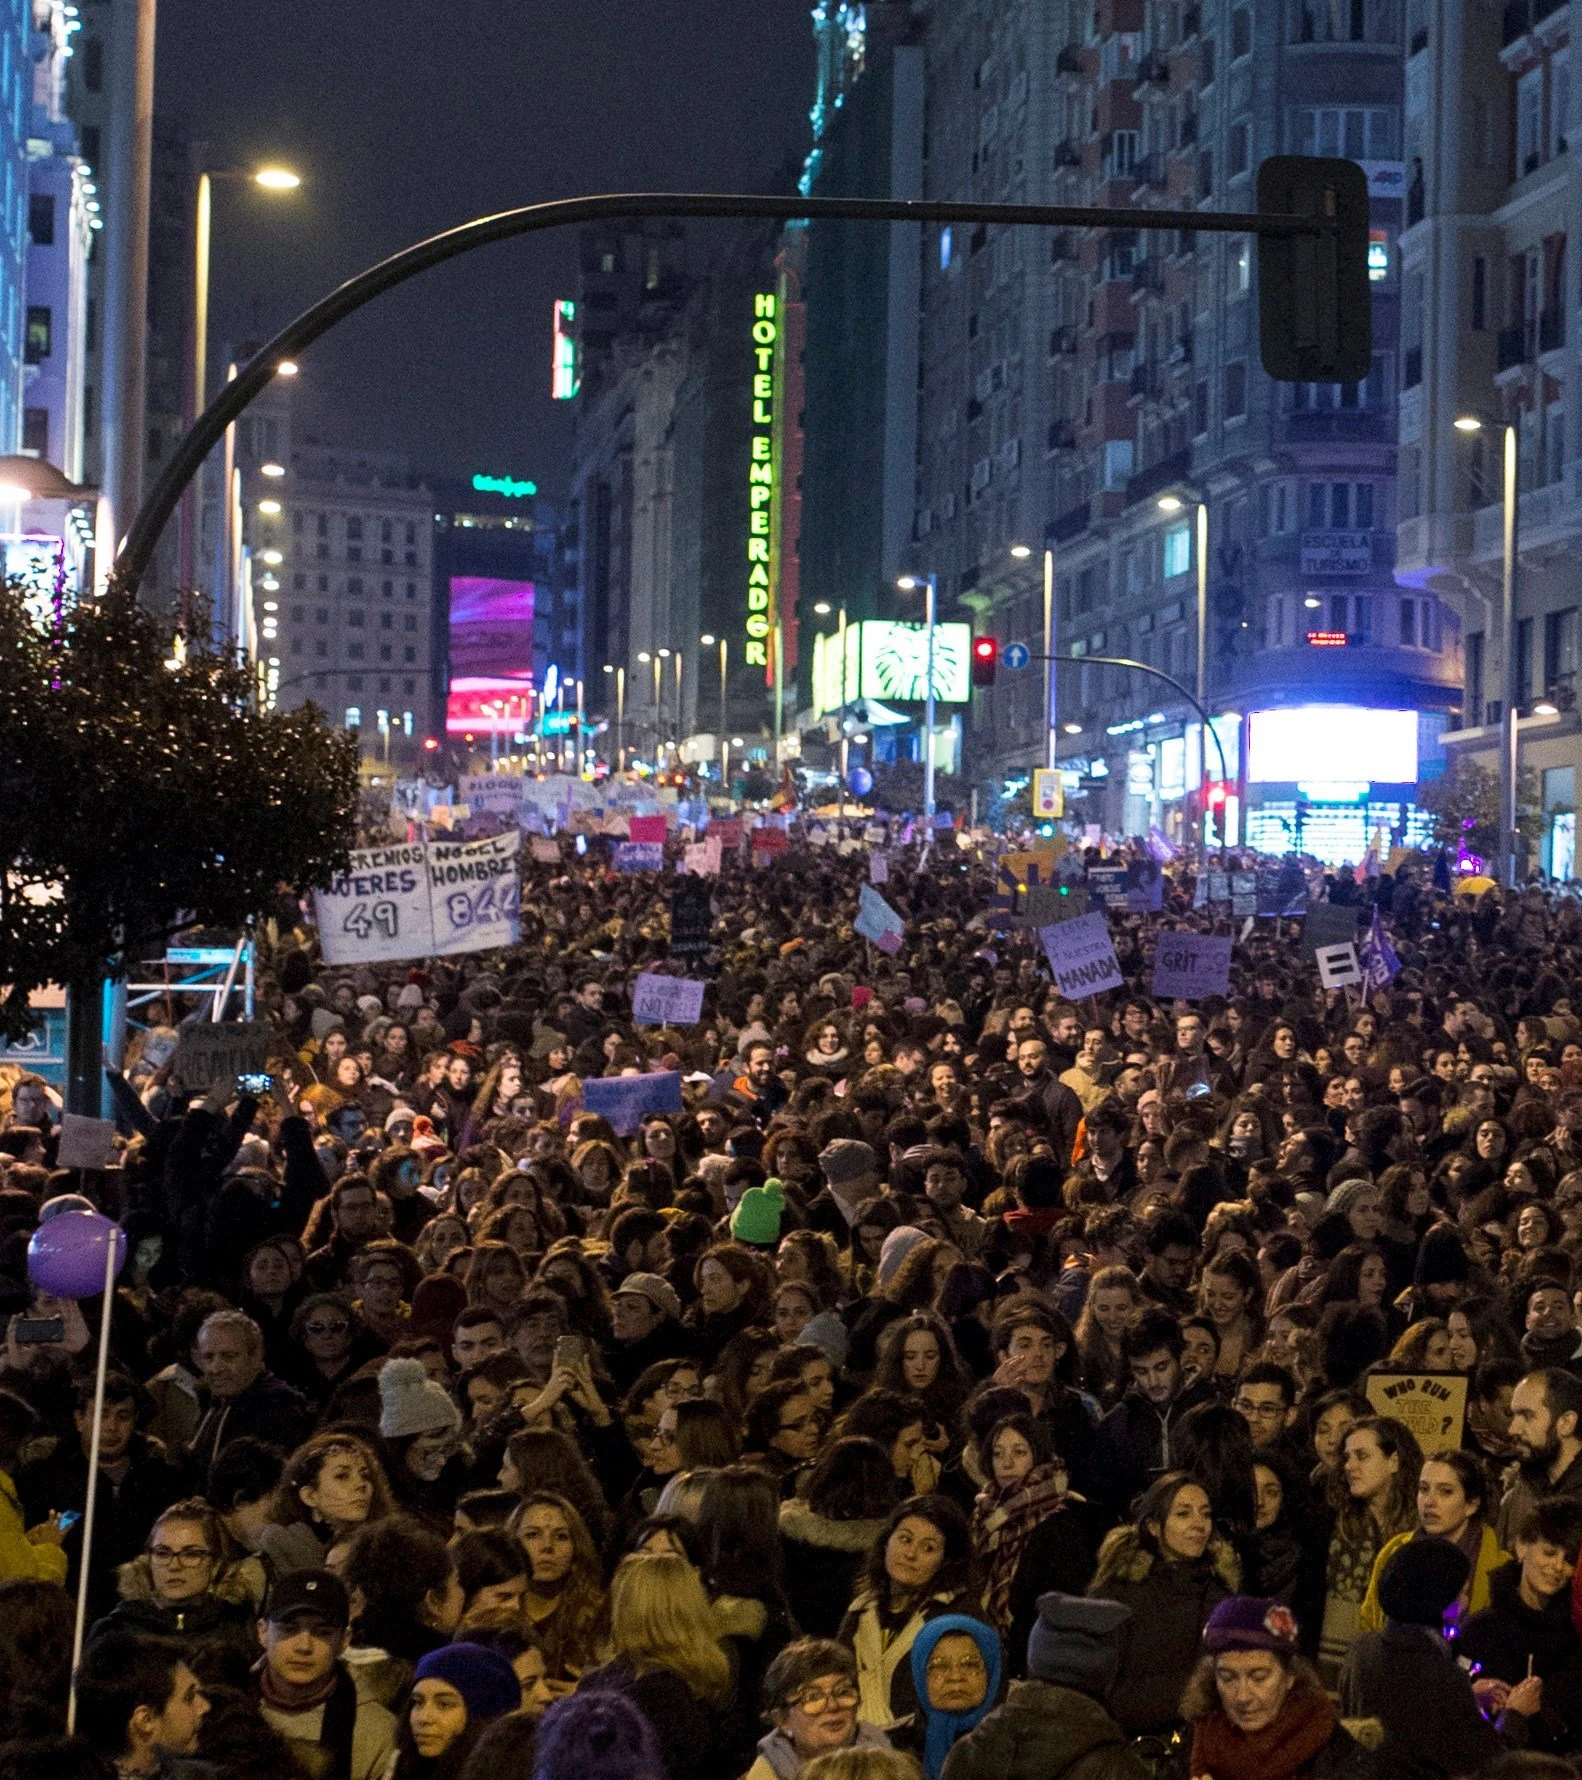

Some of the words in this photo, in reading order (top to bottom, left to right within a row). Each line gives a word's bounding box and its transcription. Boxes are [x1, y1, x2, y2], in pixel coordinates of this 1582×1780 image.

[753, 293, 777, 424] HOTEL
[745, 436, 773, 666] EMPERADOR
[344, 901, 399, 939] 49
[1058, 955, 1121, 992] MANADA
